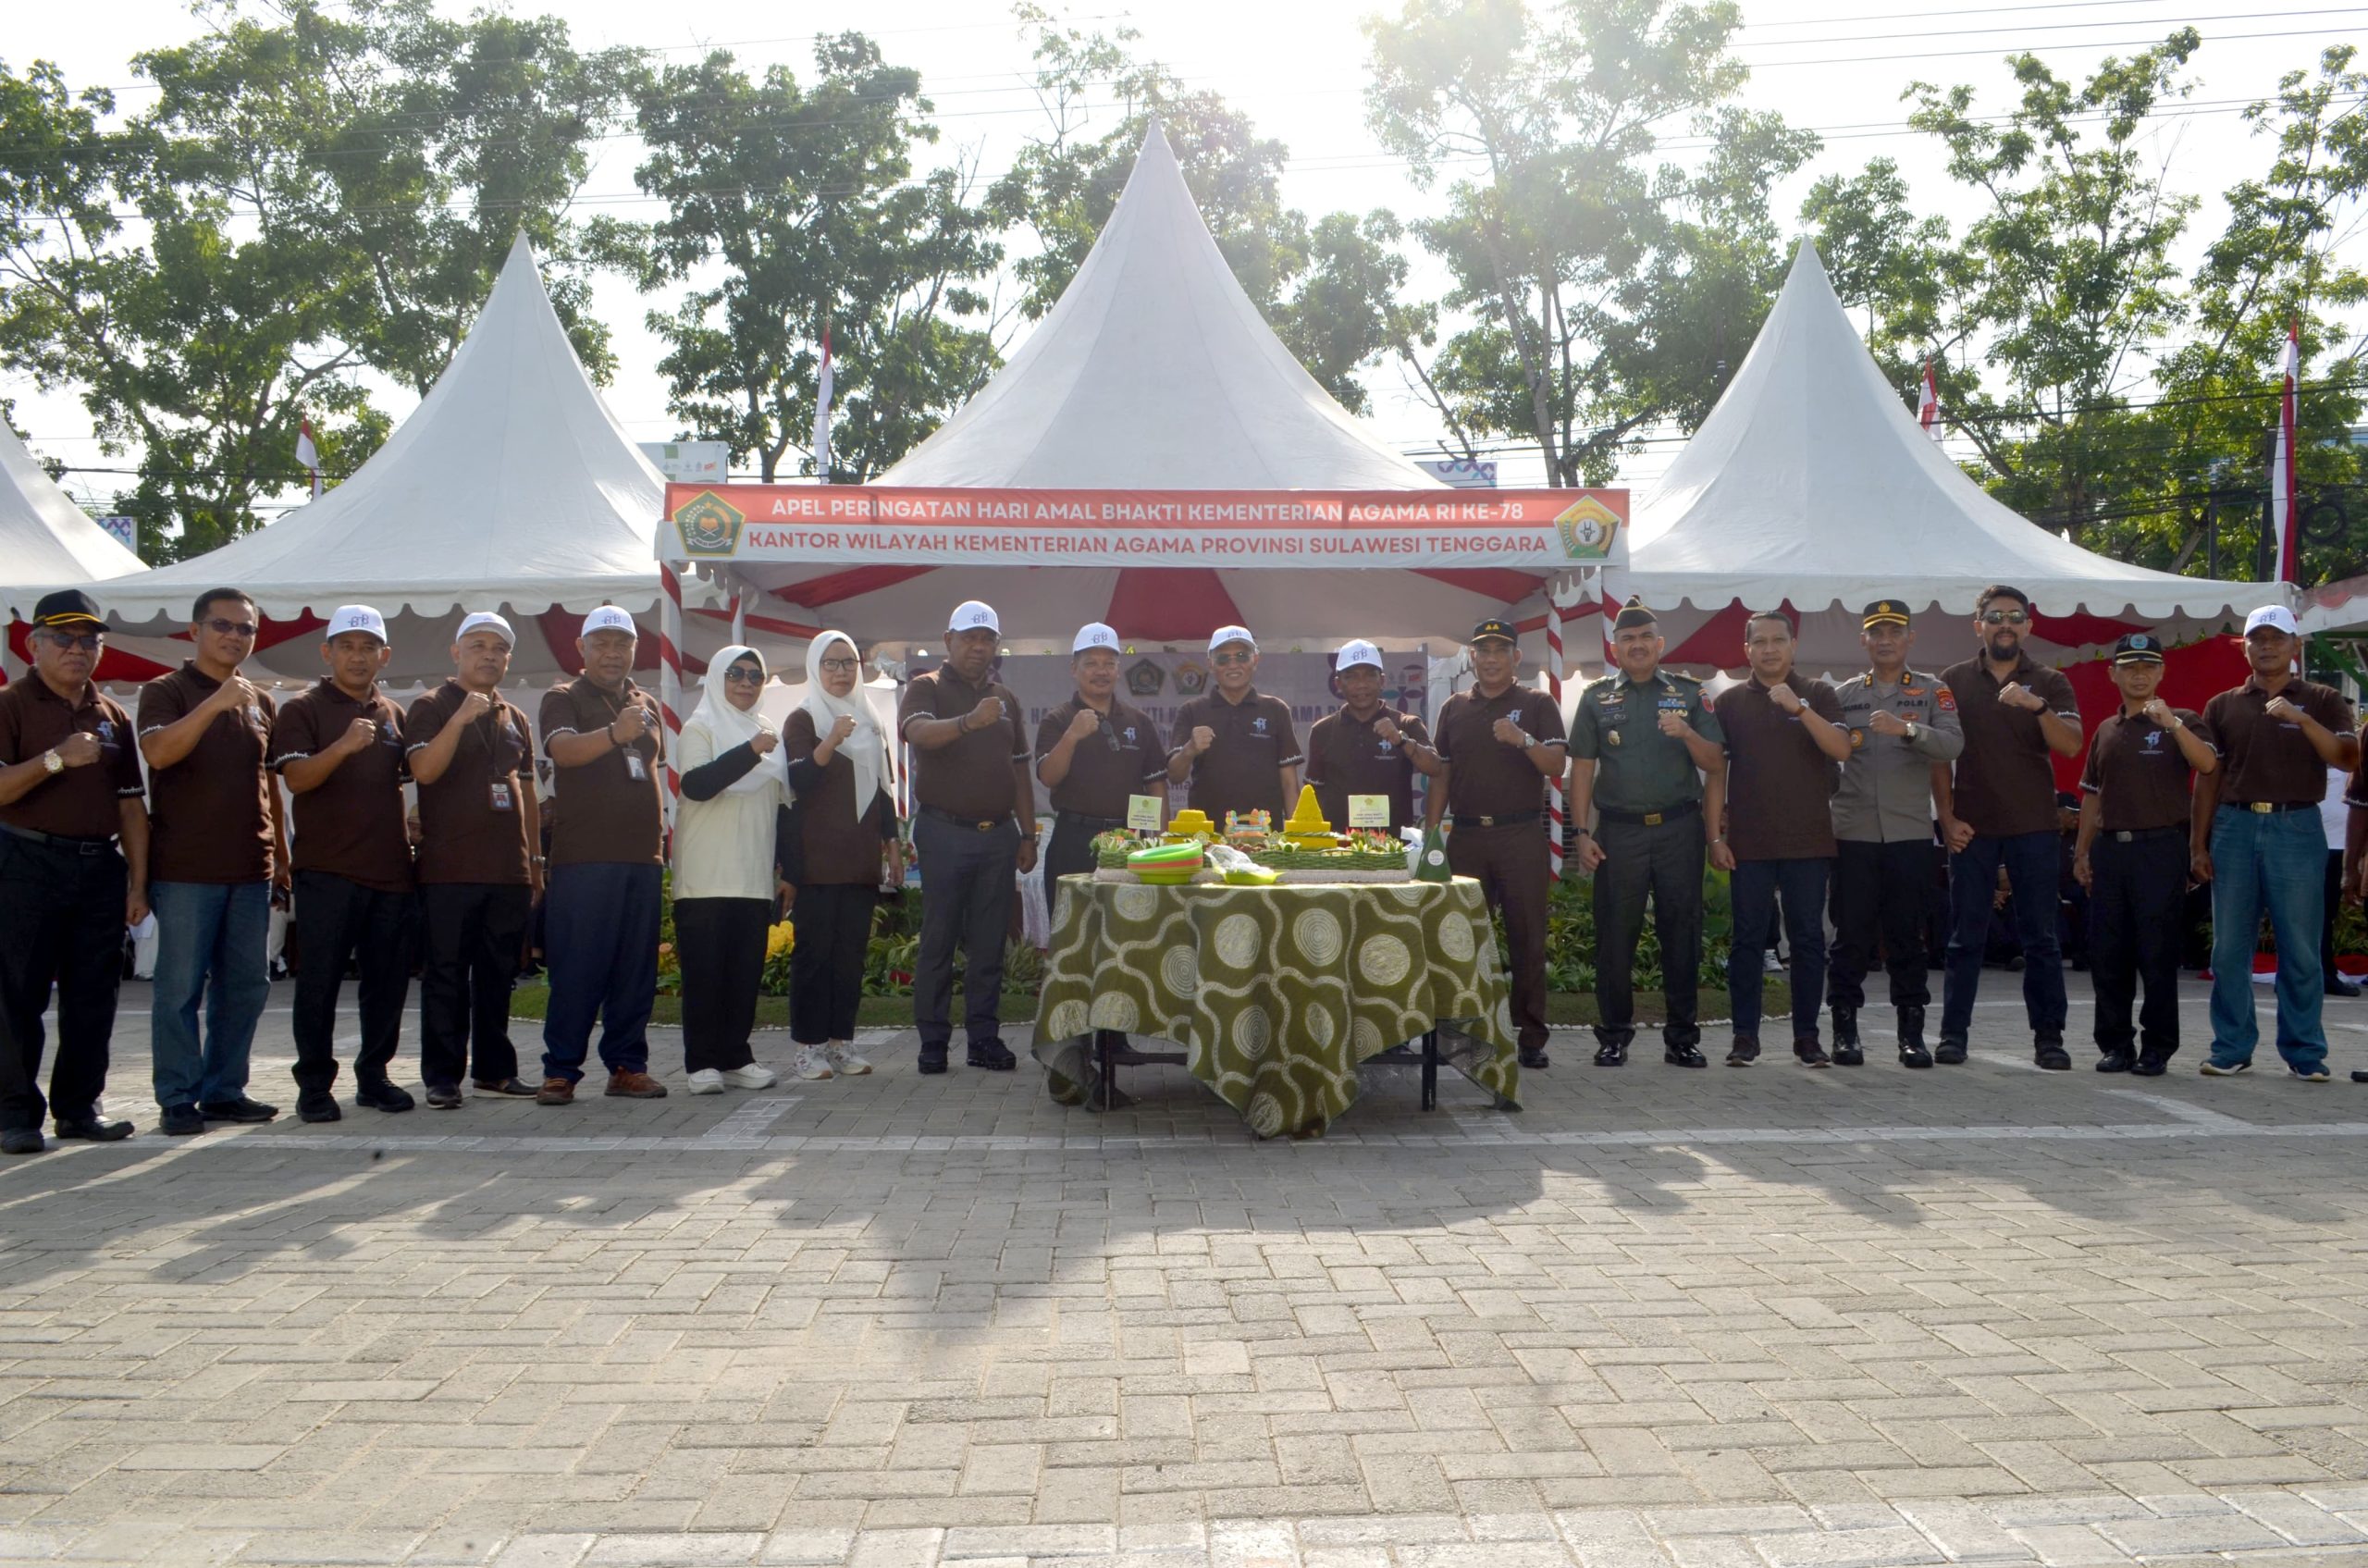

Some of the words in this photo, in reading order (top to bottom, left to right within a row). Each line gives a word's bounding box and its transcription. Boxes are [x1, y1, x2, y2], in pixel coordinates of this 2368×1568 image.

[771, 499, 825, 515] APEL
[831, 500, 971, 518] PERINGATAN
[977, 501, 1029, 519] HARI
[1034, 502, 1097, 520] AMAL
[1102, 503, 1182, 521] BHAKTI
[1188, 503, 1343, 521] KEMENTERIAN
[1348, 503, 1431, 521] AGAMA
[1436, 502, 1456, 520] RI
[1462, 502, 1523, 520] KE-78
[748, 531, 841, 549] KANTOR
[846, 533, 947, 550] WILAYAH
[954, 535, 1108, 553] KEMENTERIAN
[1114, 536, 1196, 554] AGAMA
[1201, 537, 1303, 554] PROVINSI
[1309, 537, 1421, 554] SULAWESI
[1425, 535, 1548, 553] TENGGARA
